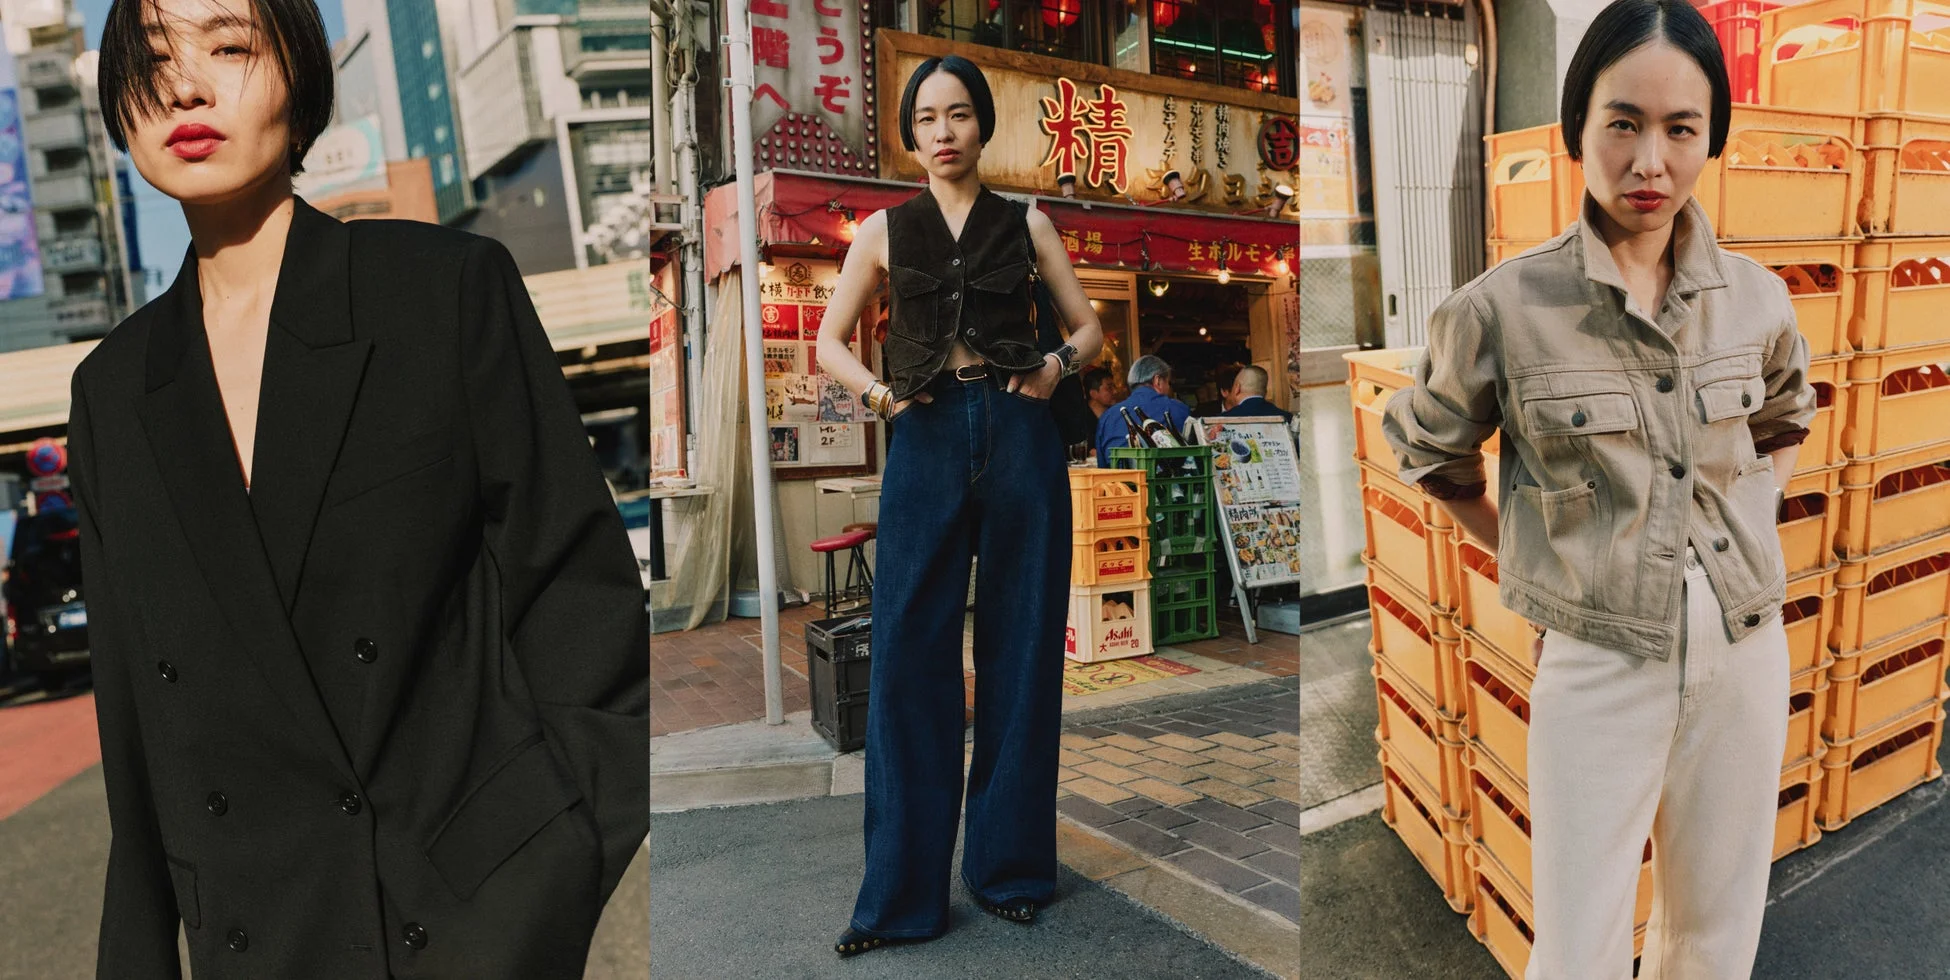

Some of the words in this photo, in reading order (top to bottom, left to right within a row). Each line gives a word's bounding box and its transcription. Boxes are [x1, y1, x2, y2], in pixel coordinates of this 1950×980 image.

[1040, 77, 1134, 194] 精
[819, 425, 837, 433] トイレ
[820, 436, 835, 446] 2F
[1105, 626, 1133, 642] Asahi
[1099, 643, 1108, 653] 大
[1130, 639, 1139, 648] 20
